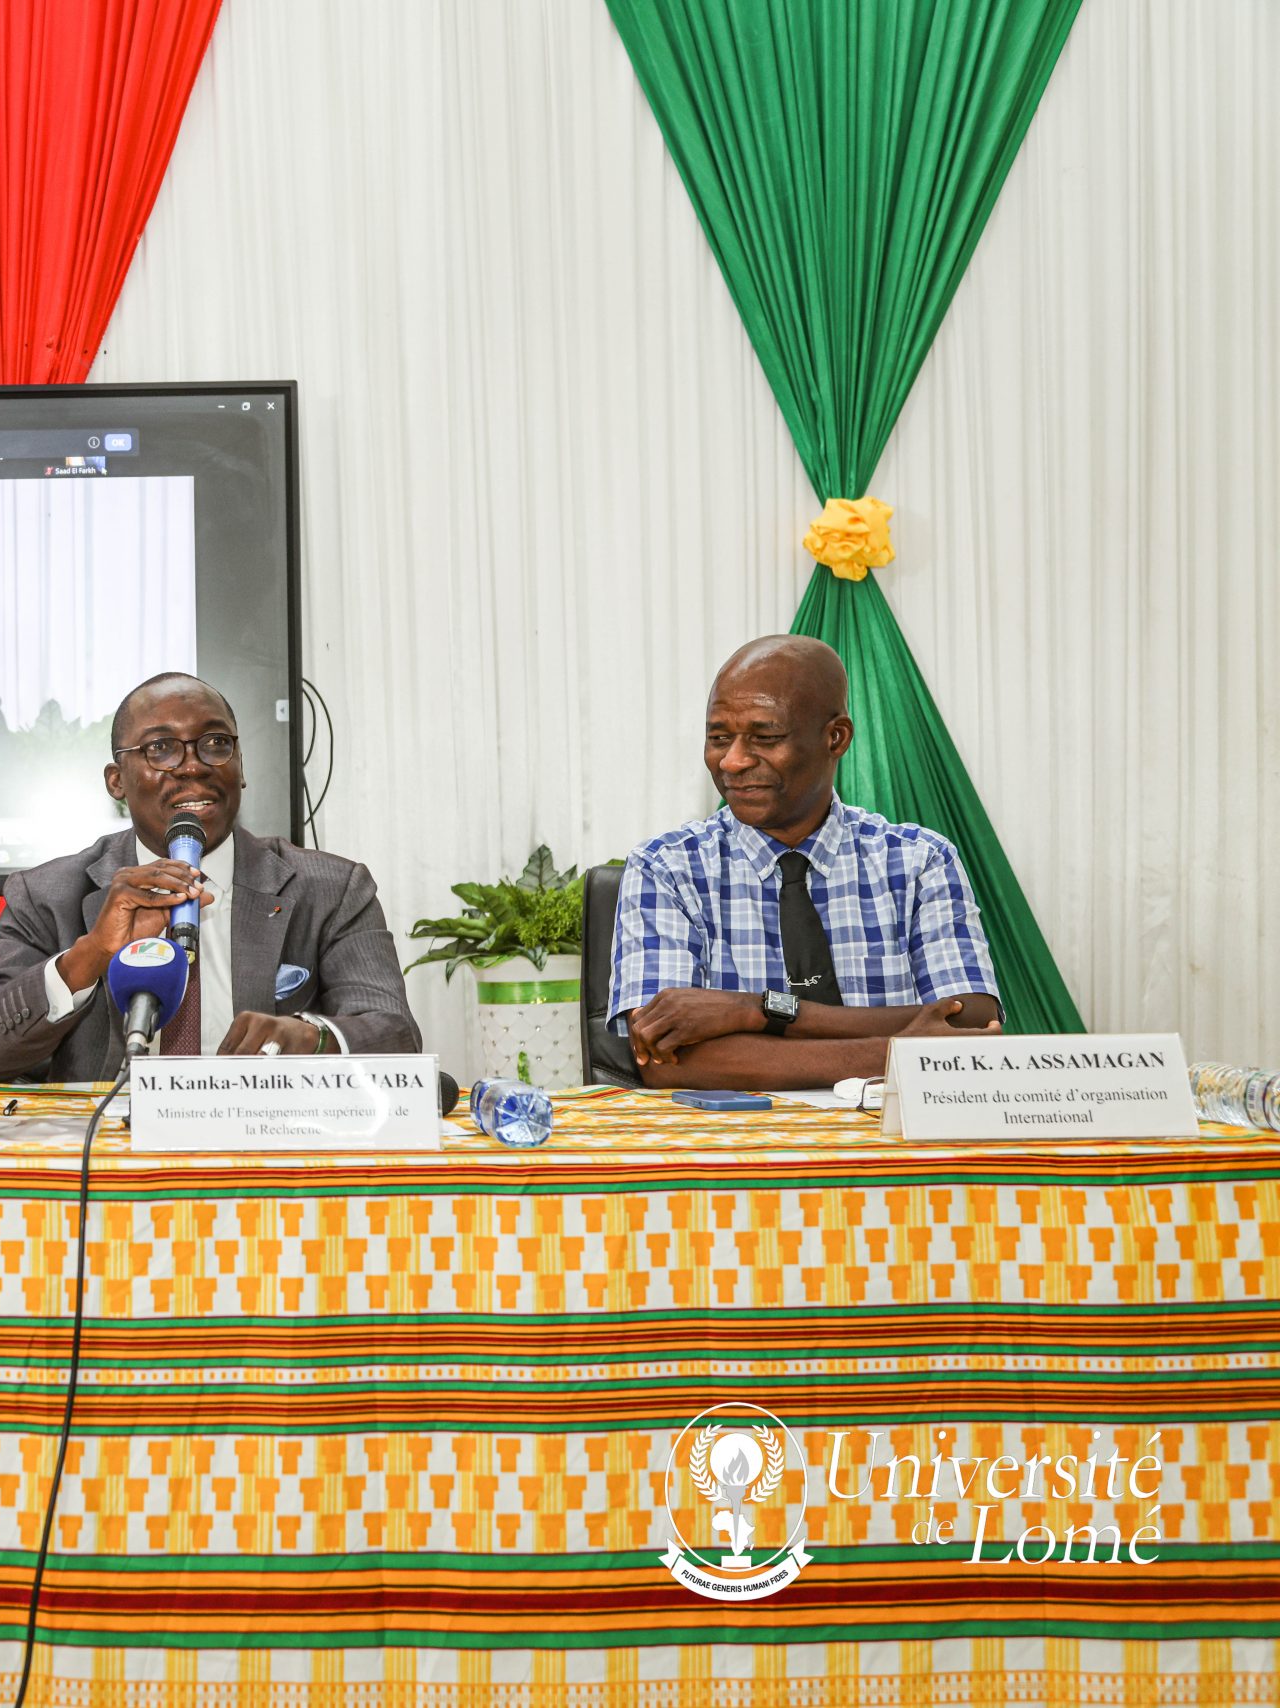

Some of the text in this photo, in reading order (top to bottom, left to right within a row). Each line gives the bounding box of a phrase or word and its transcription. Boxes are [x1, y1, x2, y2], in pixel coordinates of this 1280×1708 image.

[111, 438, 126, 447] OK
[918, 1051, 1166, 1072] Prof. K. A. ASSAMAGAN
[137, 1075, 163, 1091] M.
[169, 1073, 295, 1091] Kanka-Malik
[921, 1086, 1168, 1105] Président du comité d'organisation
[156, 1107, 207, 1119] Ministre
[209, 1107, 224, 1119] de
[227, 1106, 319, 1120] l'Enseignement
[394, 1105, 410, 1117] de
[1003, 1108, 1094, 1125] International
[244, 1123, 257, 1135] la
